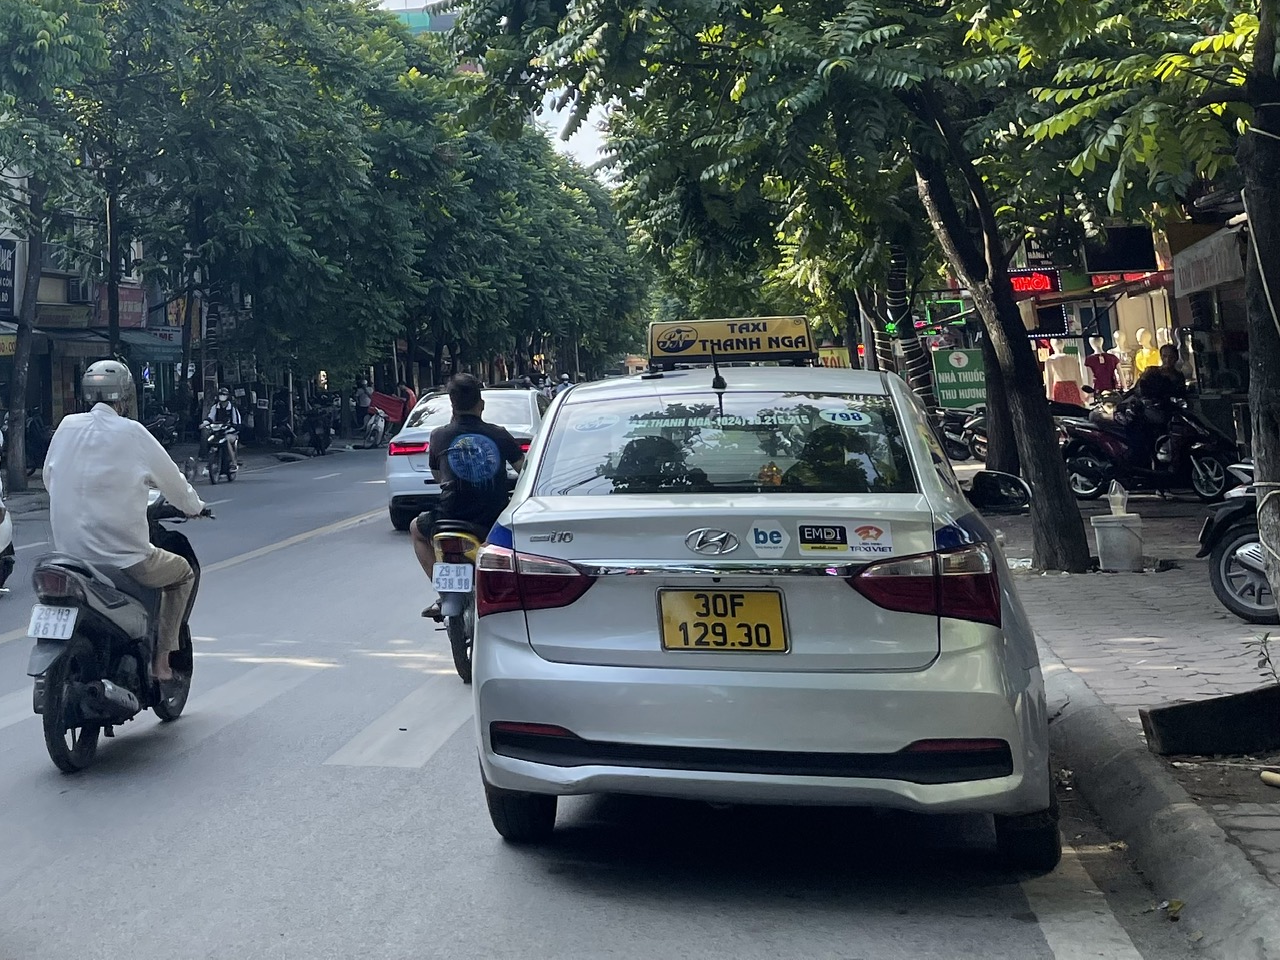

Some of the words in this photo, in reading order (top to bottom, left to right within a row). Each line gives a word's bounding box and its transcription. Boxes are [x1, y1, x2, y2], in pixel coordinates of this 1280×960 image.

[726, 322, 767, 334] TAXI
[698, 336, 761, 352] THANH
[768, 335, 807, 350] NGA
[938, 370, 957, 384] NHÀ
[940, 389, 958, 400] THU
[826, 412, 863, 422] 798
[753, 527, 783, 545] be
[693, 593, 745, 618] 30F
[678, 622, 772, 648] 129.30
